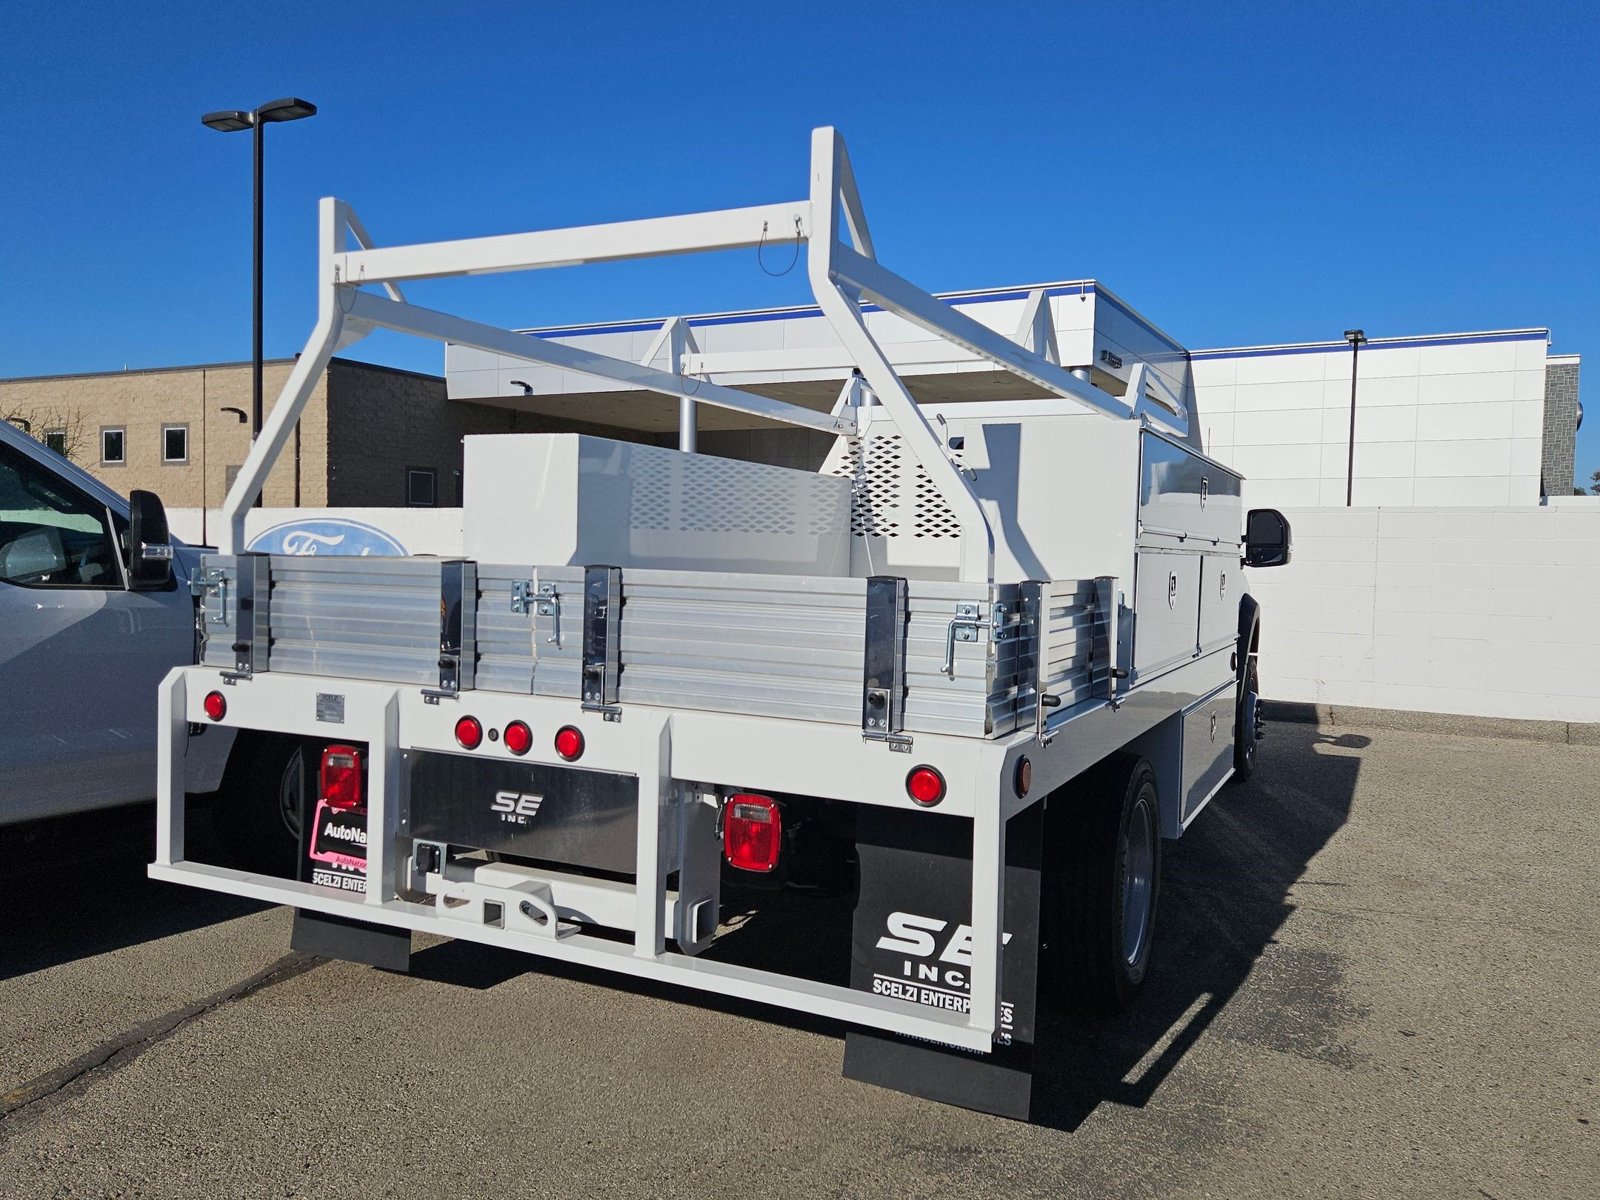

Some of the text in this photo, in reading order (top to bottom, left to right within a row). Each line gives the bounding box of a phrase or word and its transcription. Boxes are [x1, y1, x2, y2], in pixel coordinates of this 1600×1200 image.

[490, 791, 543, 816] SE
[324, 822, 367, 843] AutoNa
[312, 872, 341, 888] SCELZI
[873, 979, 918, 1002] SCELZI
